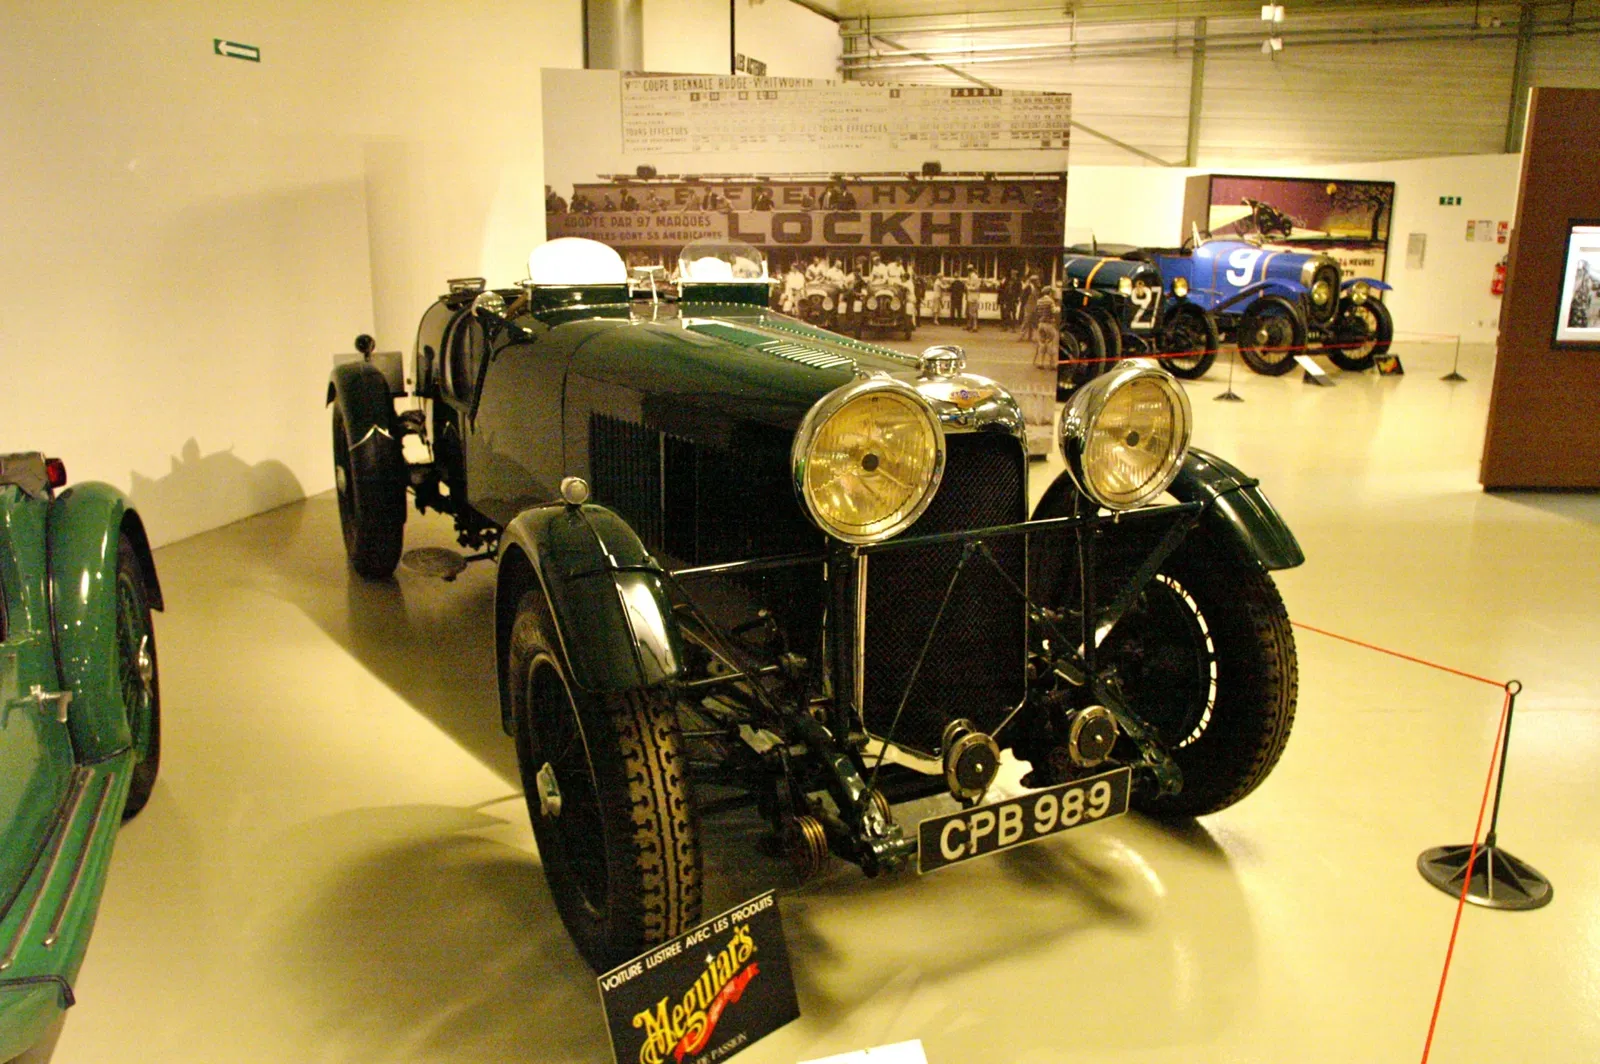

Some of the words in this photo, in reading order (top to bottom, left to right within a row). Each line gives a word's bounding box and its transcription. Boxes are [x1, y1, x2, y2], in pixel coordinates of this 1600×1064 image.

[643, 79, 669, 92] COUPE
[673, 78, 713, 91] BIENNALE
[611, 217, 632, 228] PAR
[637, 217, 650, 227] 97
[656, 217, 711, 227] MARQUES
[1226, 248, 1263, 287] 9
[940, 803, 1024, 860] CPB
[1034, 780, 1112, 834] 989
[602, 962, 644, 991] VOITURE
[685, 927, 711, 949] AVEC
[713, 918, 729, 933] LES
[731, 895, 773, 925] PRODUITS
[632, 924, 757, 1064] Meguiar's
